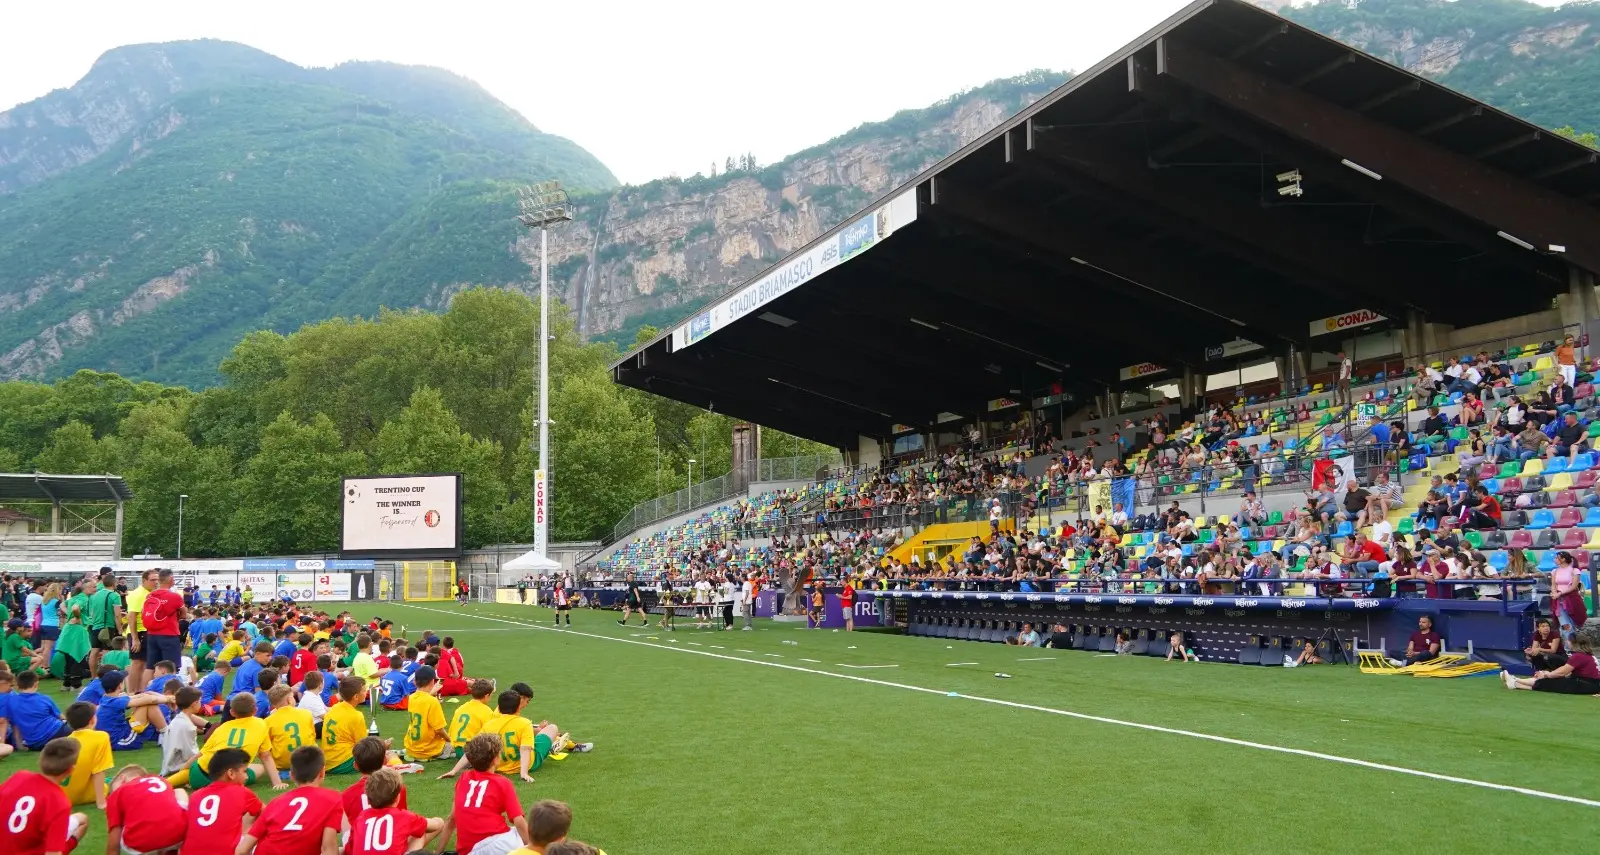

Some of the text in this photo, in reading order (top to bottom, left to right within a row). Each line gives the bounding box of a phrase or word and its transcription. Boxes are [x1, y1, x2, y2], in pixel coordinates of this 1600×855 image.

[729, 256, 813, 319] STADIO BRIAMASCO
[1336, 311, 1379, 328] CONAD
[391, 500, 421, 508] WINNER
[1192, 597, 1214, 607] TRENTINO
[1234, 598, 1258, 608] TRENTINO
[1280, 598, 1306, 609] TRENTINO
[1352, 598, 1380, 609] TRENTINO
[294, 653, 303, 669] 5
[380, 678, 395, 697] 15
[284, 722, 302, 752] 3
[325, 718, 338, 746] 5
[456, 713, 471, 742] 2
[139, 776, 168, 793] 3
[463, 779, 489, 808] 11
[8, 795, 36, 834] 8
[197, 794, 221, 827] 9
[282, 796, 309, 831] 2
[363, 813, 394, 852] 10
